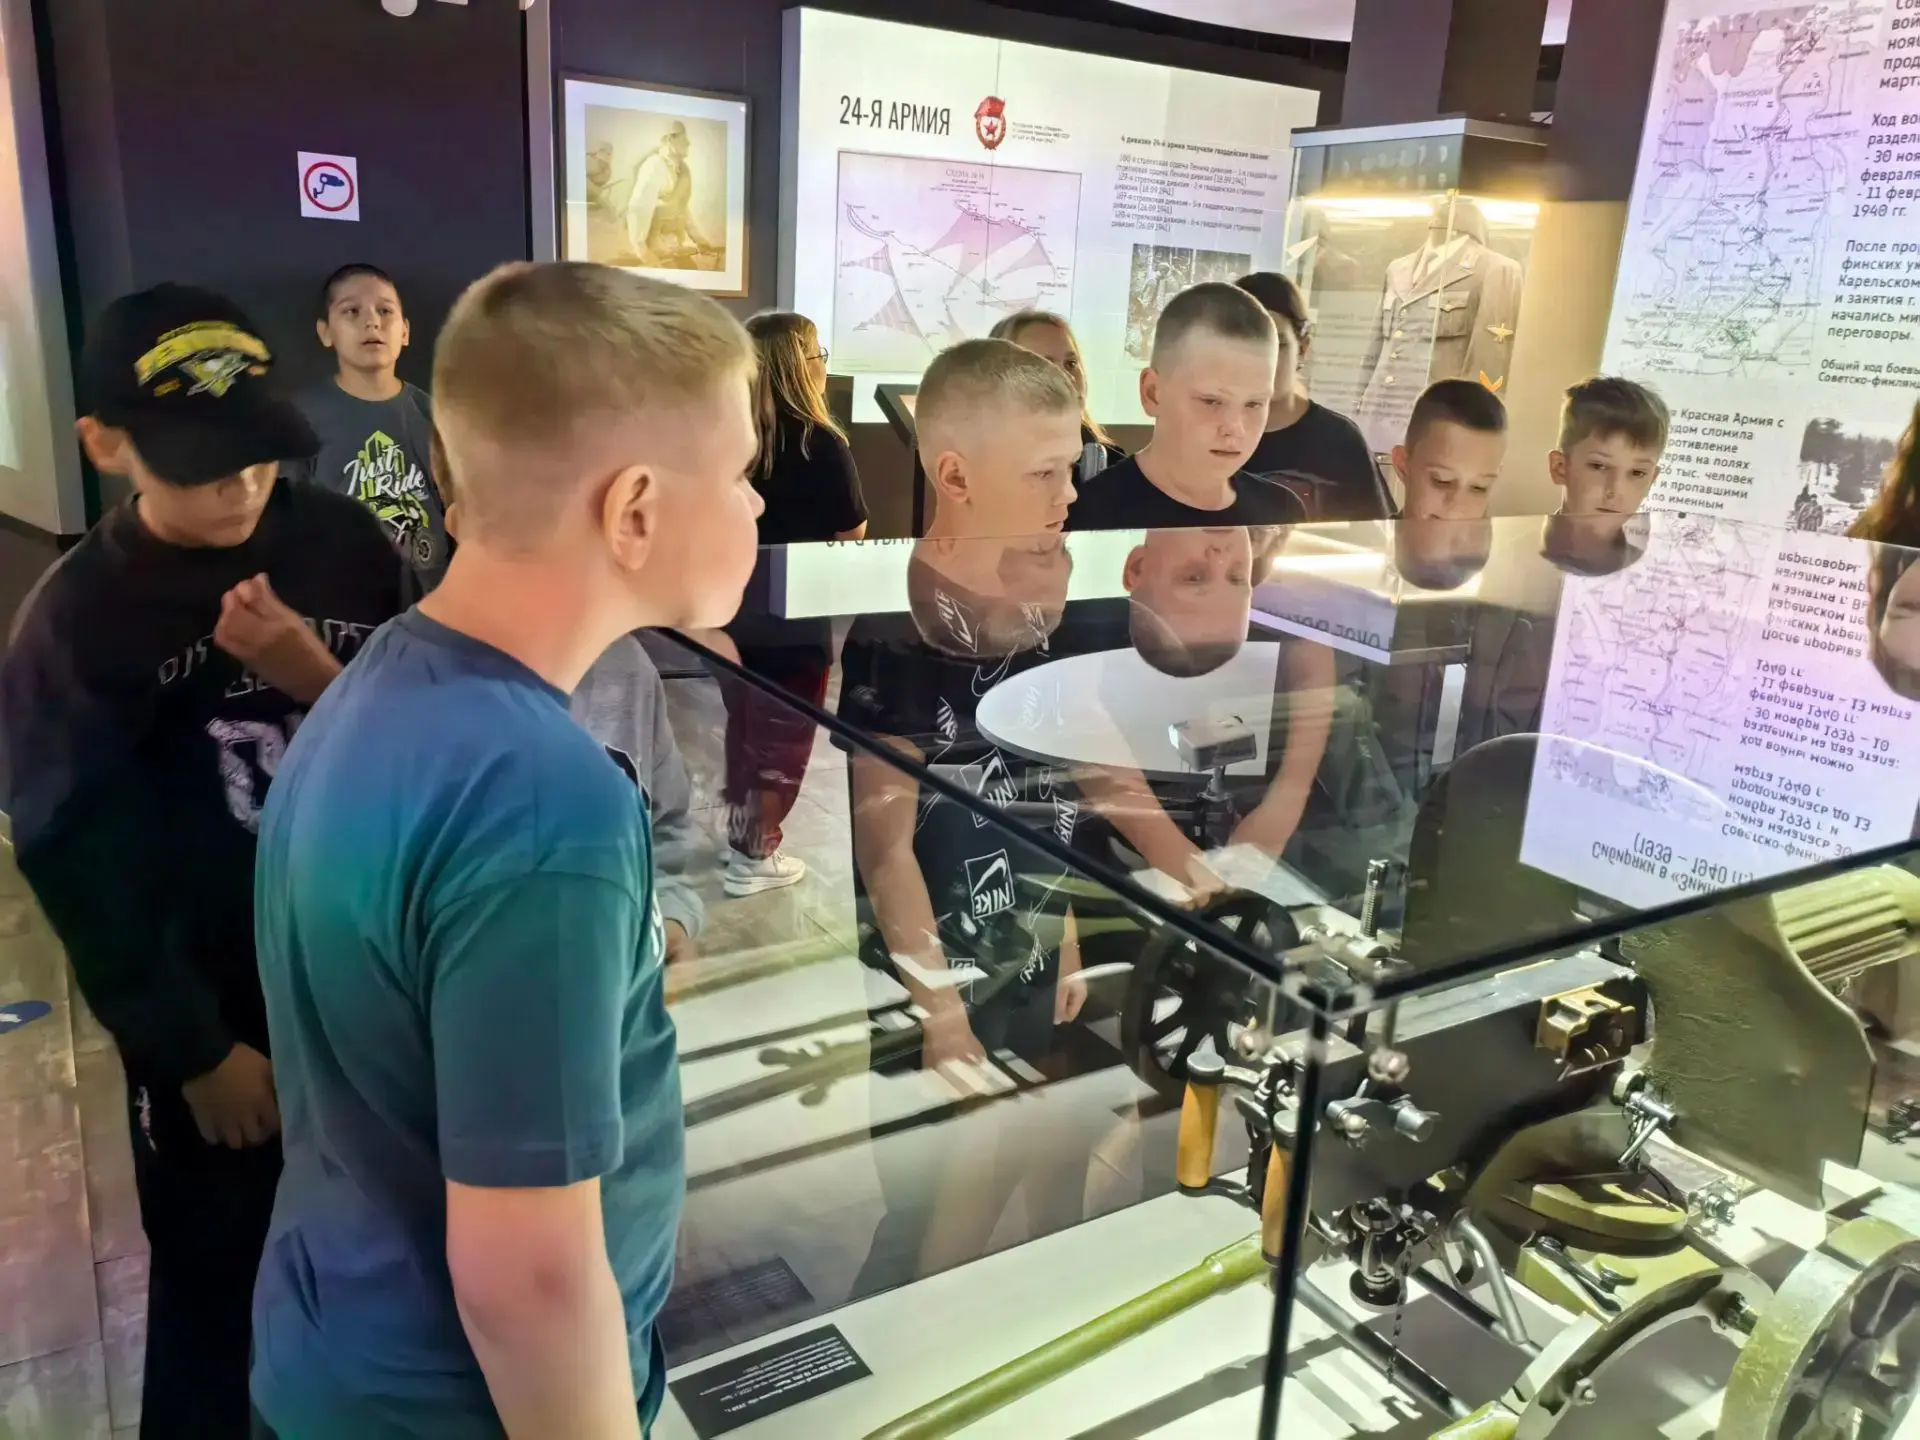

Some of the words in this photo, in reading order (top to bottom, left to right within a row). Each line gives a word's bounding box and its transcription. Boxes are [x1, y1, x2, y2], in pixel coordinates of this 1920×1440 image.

[1887, 34, 1920, 50] ноя
[1879, 75, 1920, 91] март
[839, 95, 883, 129] 24-Я
[888, 101, 951, 136] АРМИЯ
[1872, 113, 1897, 128] Ход
[1901, 114, 1920, 126] во
[1873, 149, 1892, 164] 30
[1866, 186, 1881, 199] 11
[1852, 203, 1888, 218] 1940
[1845, 239, 1887, 253] После
[1891, 242, 1920, 256] про
[1841, 257, 1902, 274] финских
[1838, 274, 1920, 290] Карельском
[1834, 293, 1843, 304] и
[1847, 293, 1904, 306] занятия
[1830, 310, 1895, 324] начались
[1827, 326, 1915, 342] переговоры.
[1821, 359, 1860, 373] Общий
[1680, 408, 1729, 424] Красная
[1732, 413, 1774, 428] Армия
[1701, 426, 1754, 441] сломила
[343, 444, 402, 496] Just
[1695, 456, 1710, 466] на
[1713, 458, 1751, 470] полях
[375, 463, 426, 499] Ride
[1676, 469, 1701, 480] тыс.
[1705, 473, 1756, 486] человек
[1670, 481, 1749, 500] пропавшими
[1668, 495, 1725, 511] именным
[974, 881, 1011, 915] NIKE
